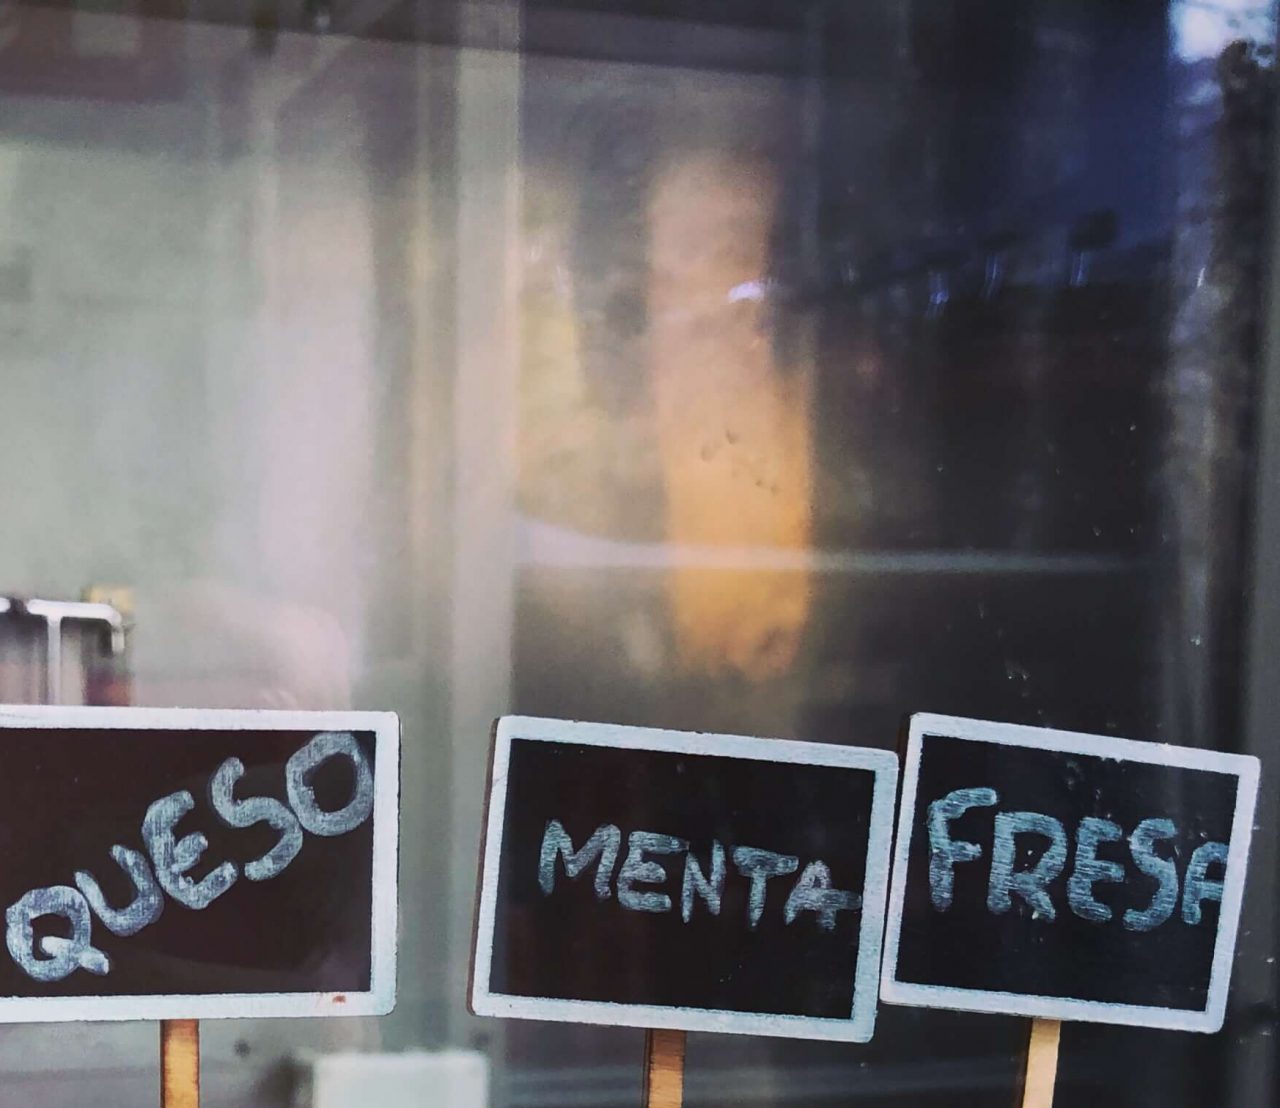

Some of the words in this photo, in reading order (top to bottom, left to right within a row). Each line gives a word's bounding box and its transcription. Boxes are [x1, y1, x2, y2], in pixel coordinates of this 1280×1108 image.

[6, 731, 374, 982] QUESO
[538, 819, 862, 930] MENTA
[928, 787, 1230, 931] FRESA
